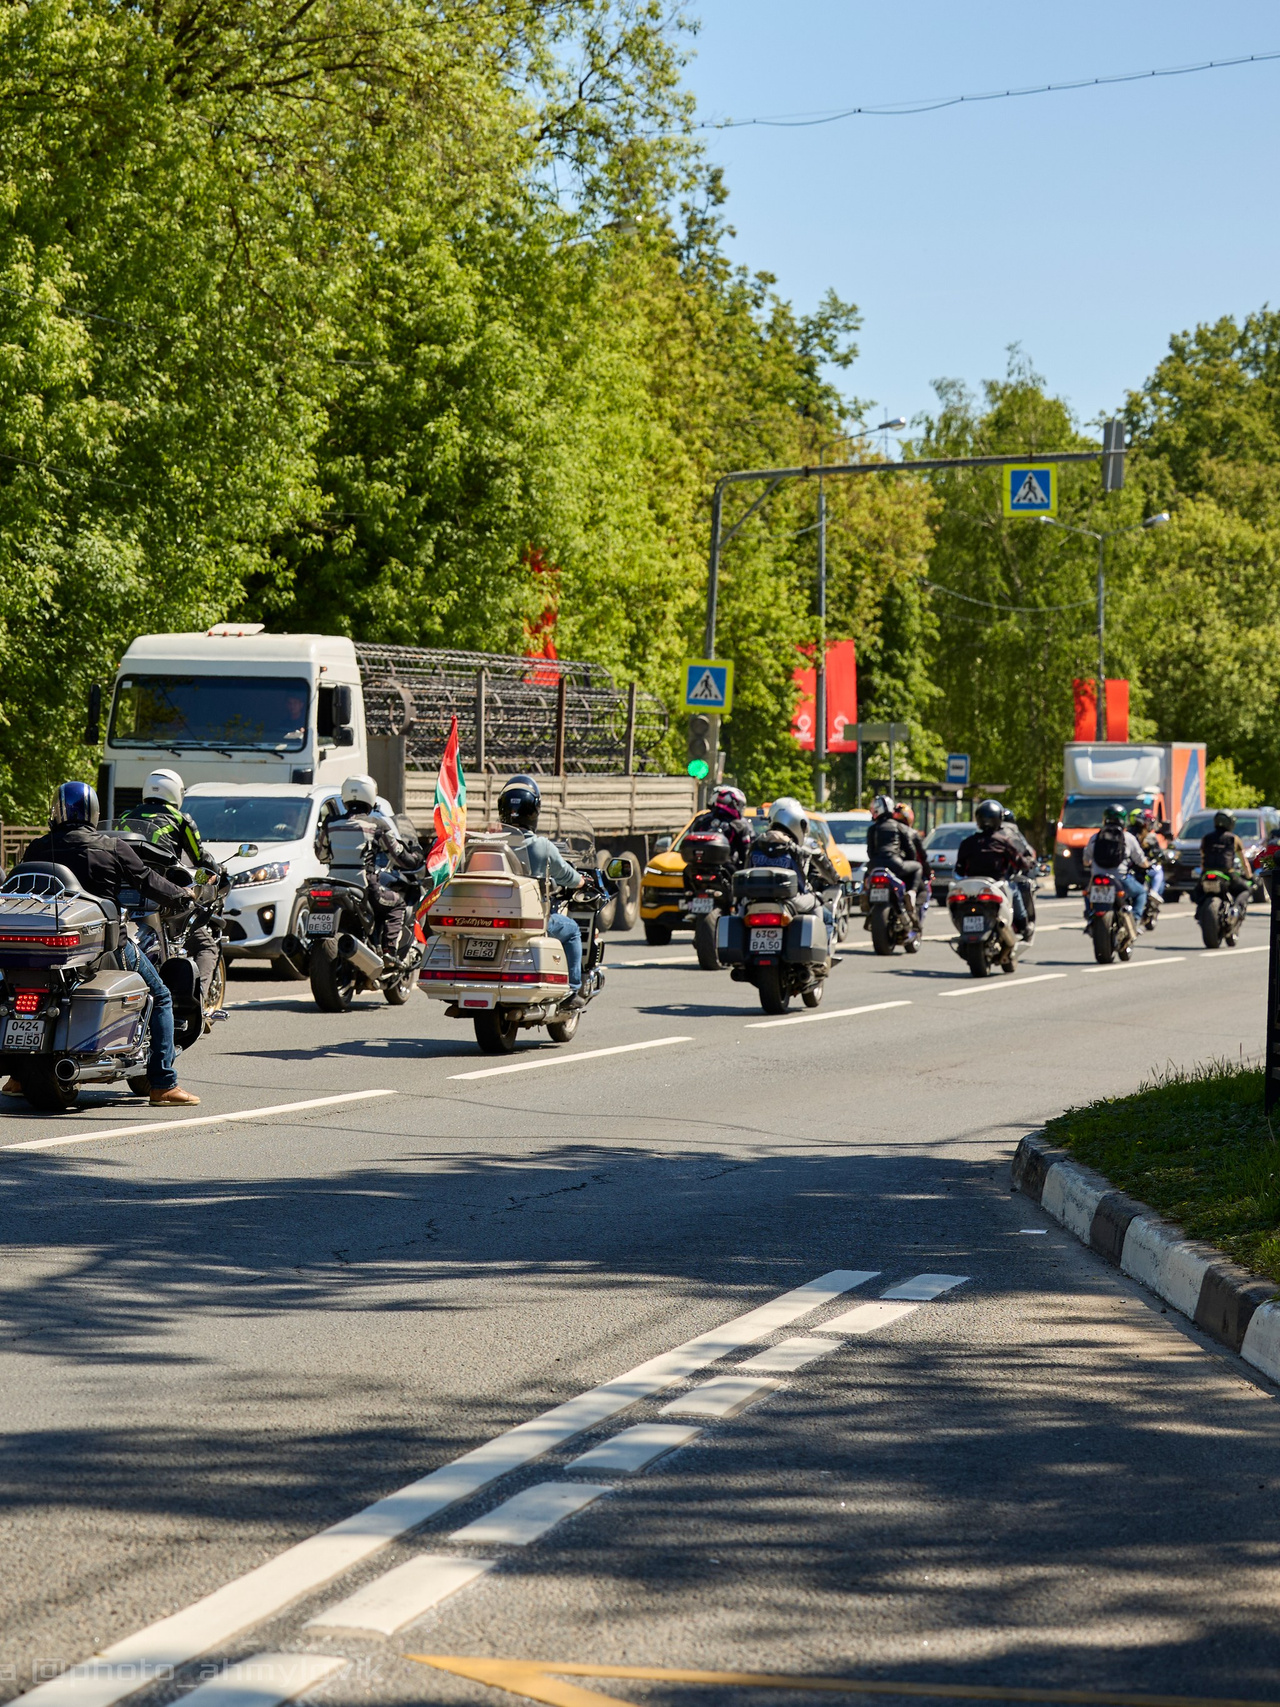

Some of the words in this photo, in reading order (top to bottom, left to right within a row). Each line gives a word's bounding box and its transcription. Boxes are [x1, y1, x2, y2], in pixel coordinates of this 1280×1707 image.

[472, 940, 494, 948] 3120
[768, 941, 780, 950] 50
[11, 1021, 39, 1031] 0424
[26, 1035, 40, 1045] 50
